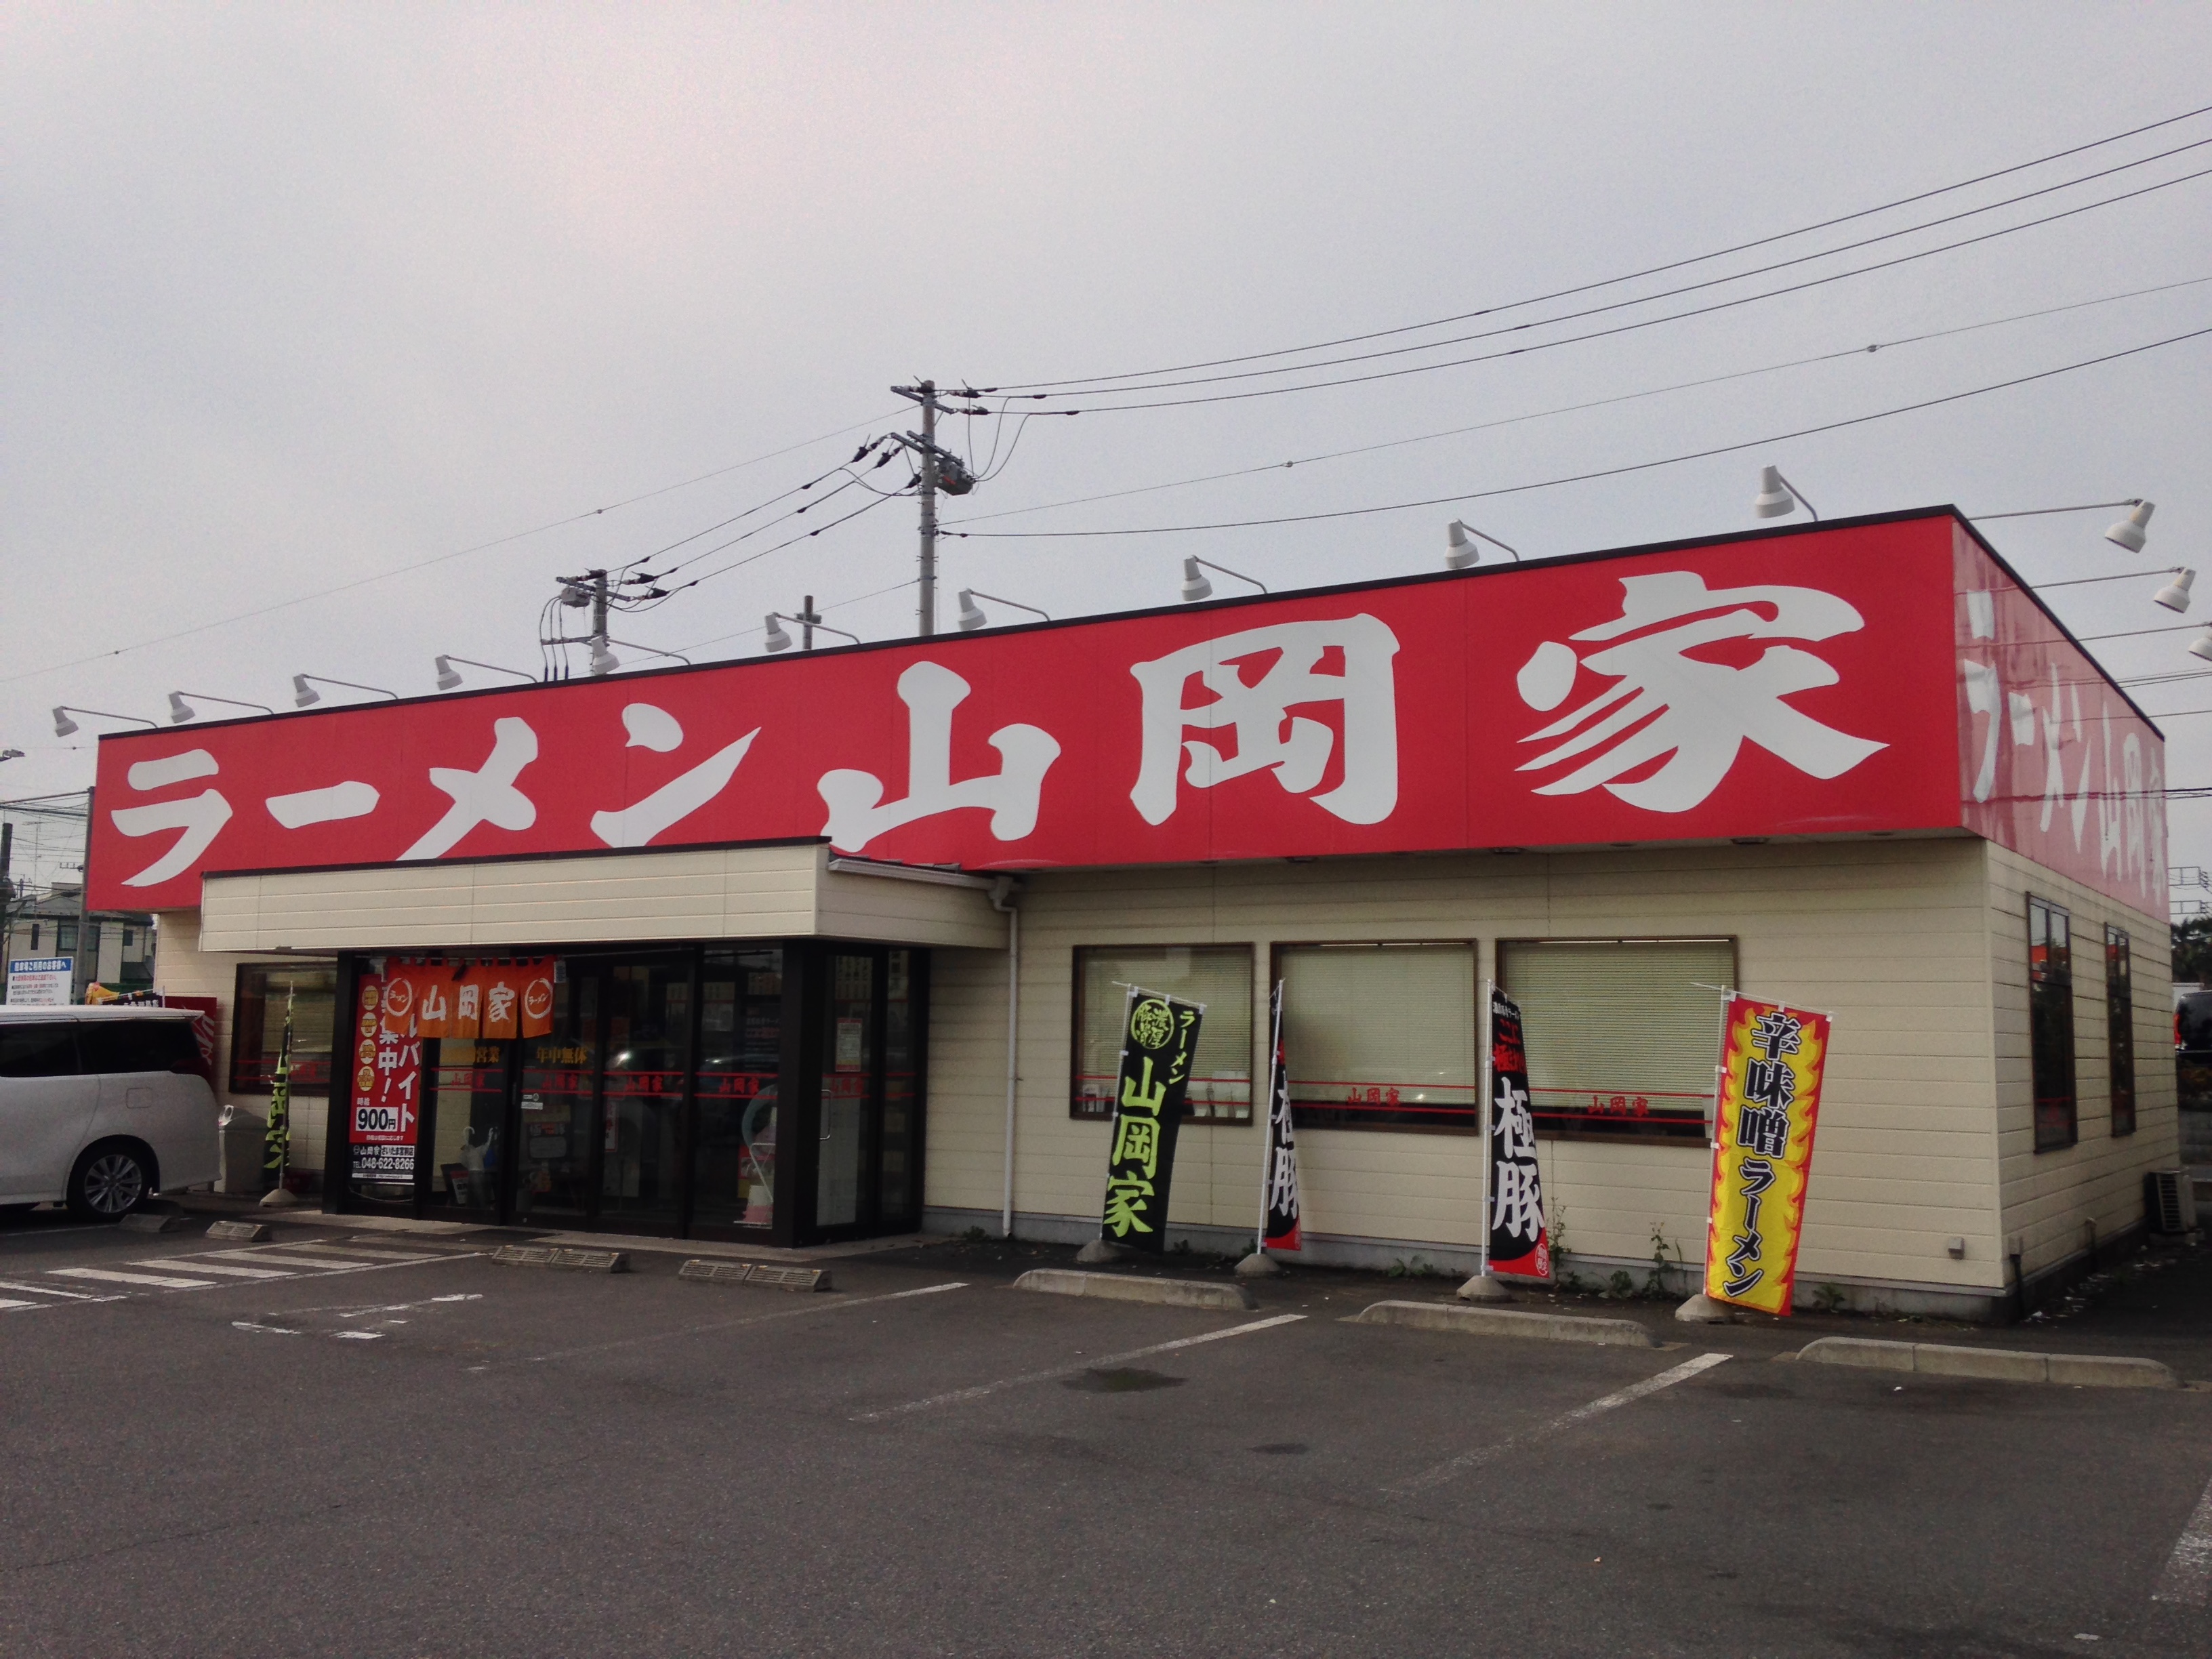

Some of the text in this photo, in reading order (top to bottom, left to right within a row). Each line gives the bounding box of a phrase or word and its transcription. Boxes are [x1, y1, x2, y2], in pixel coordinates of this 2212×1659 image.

[421, 981, 516, 1023] 山岡家
[537, 1047, 588, 1063] 年中無休
[1168, 1010, 1196, 1086] ラーメン
[1346, 1086, 1401, 1106] 山岡家
[1586, 1095, 1650, 1116] 山岡家
[357, 1108, 396, 1130] 900円
[1103, 1056, 1167, 1237] 山岡家
[1492, 1076, 1546, 1243] 極豚
[1723, 1012, 1802, 1297] 辛味噌ラーメン
